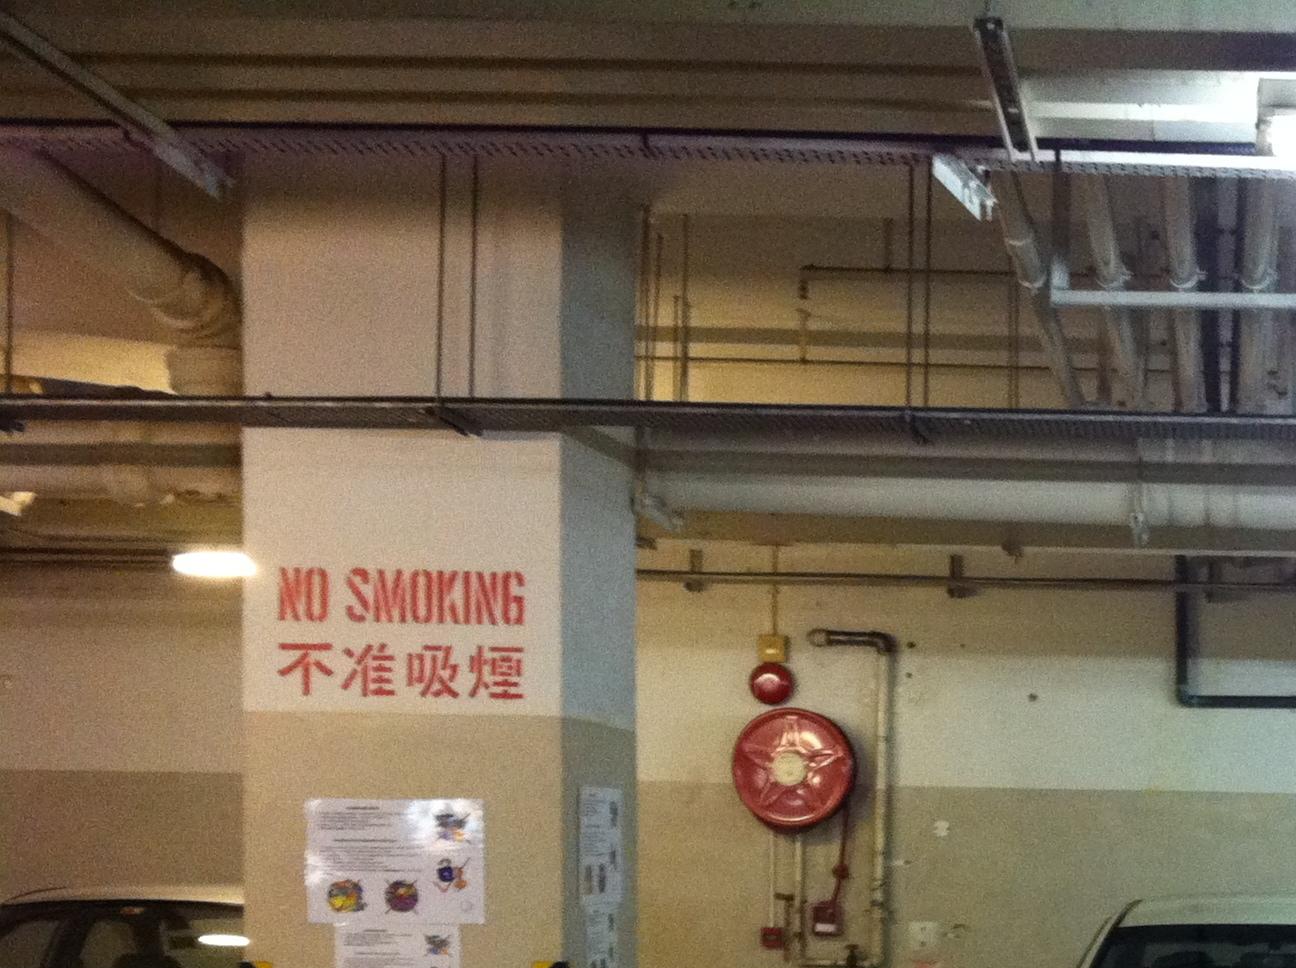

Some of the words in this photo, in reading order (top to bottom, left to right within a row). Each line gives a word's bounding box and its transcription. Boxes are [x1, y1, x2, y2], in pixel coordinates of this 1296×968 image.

[278, 566, 330, 622] NO
[346, 566, 526, 626] SMOKING
[277, 642, 525, 700] 不准吸煙
